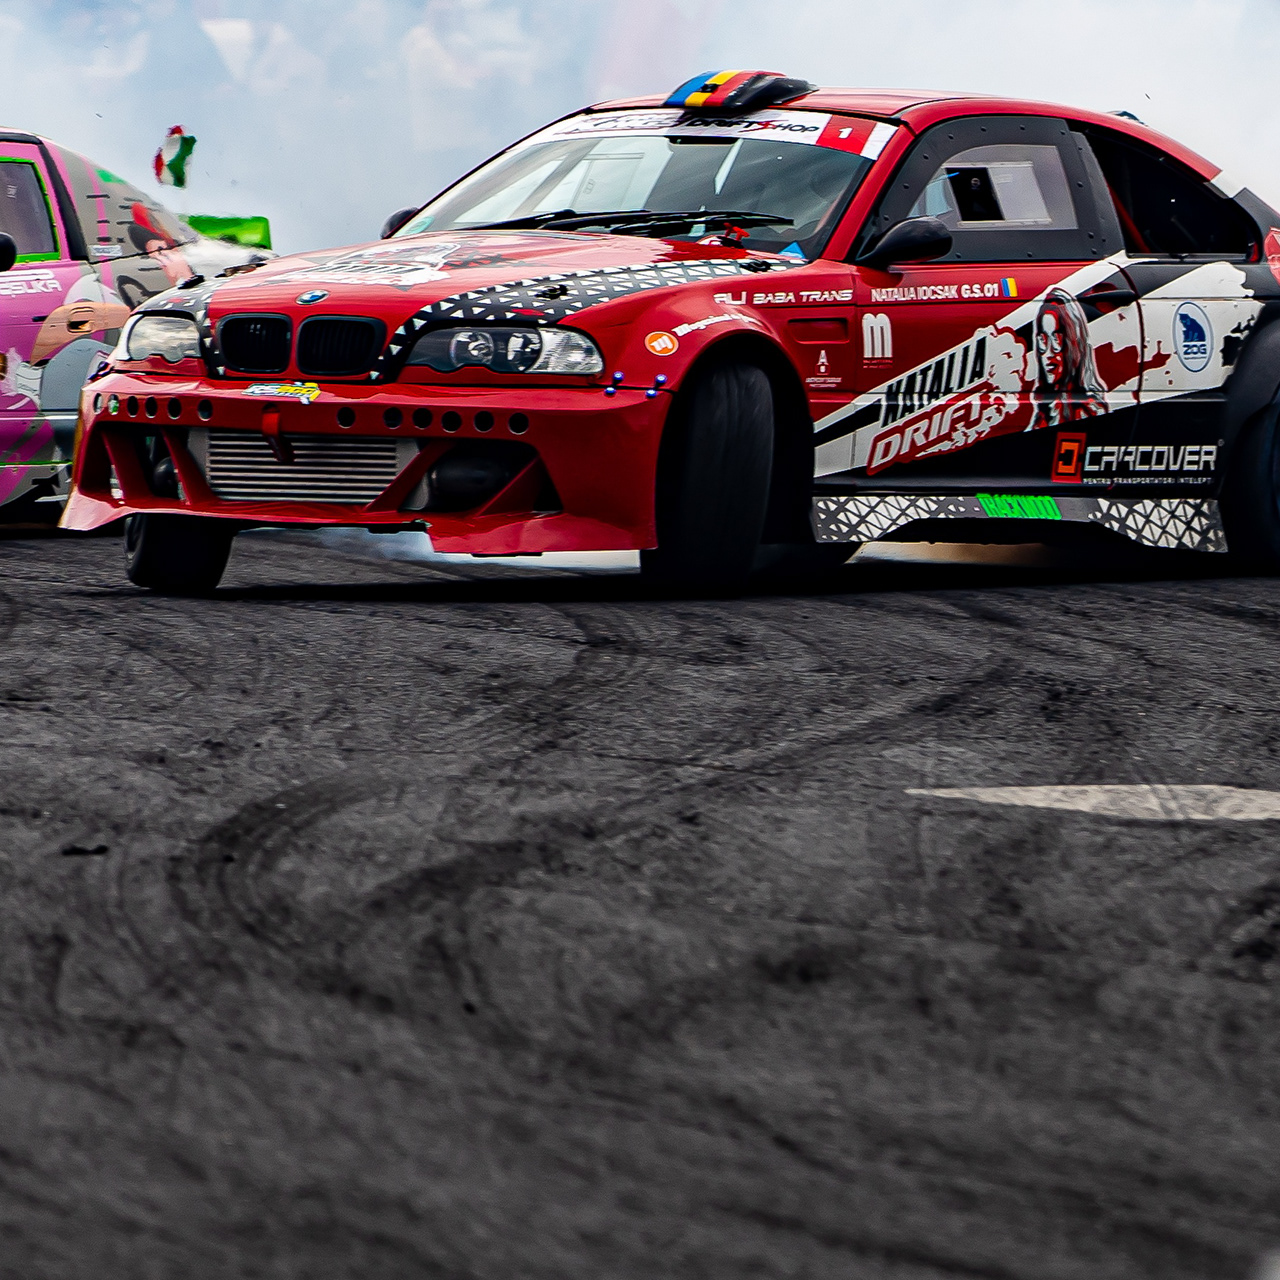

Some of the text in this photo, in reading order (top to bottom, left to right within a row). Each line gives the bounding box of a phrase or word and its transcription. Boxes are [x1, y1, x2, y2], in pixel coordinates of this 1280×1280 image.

[837, 126, 853, 140] 1
[713, 289, 854, 305] ALI BABA TRANS
[870, 286, 918, 302] NATALIA
[961, 283, 999, 298] G.S.01
[1182, 344, 1208, 355] ZOG
[881, 335, 987, 429] NATALIA
[870, 388, 988, 469] DRIFT
[1083, 444, 1218, 472] CARCOVER
